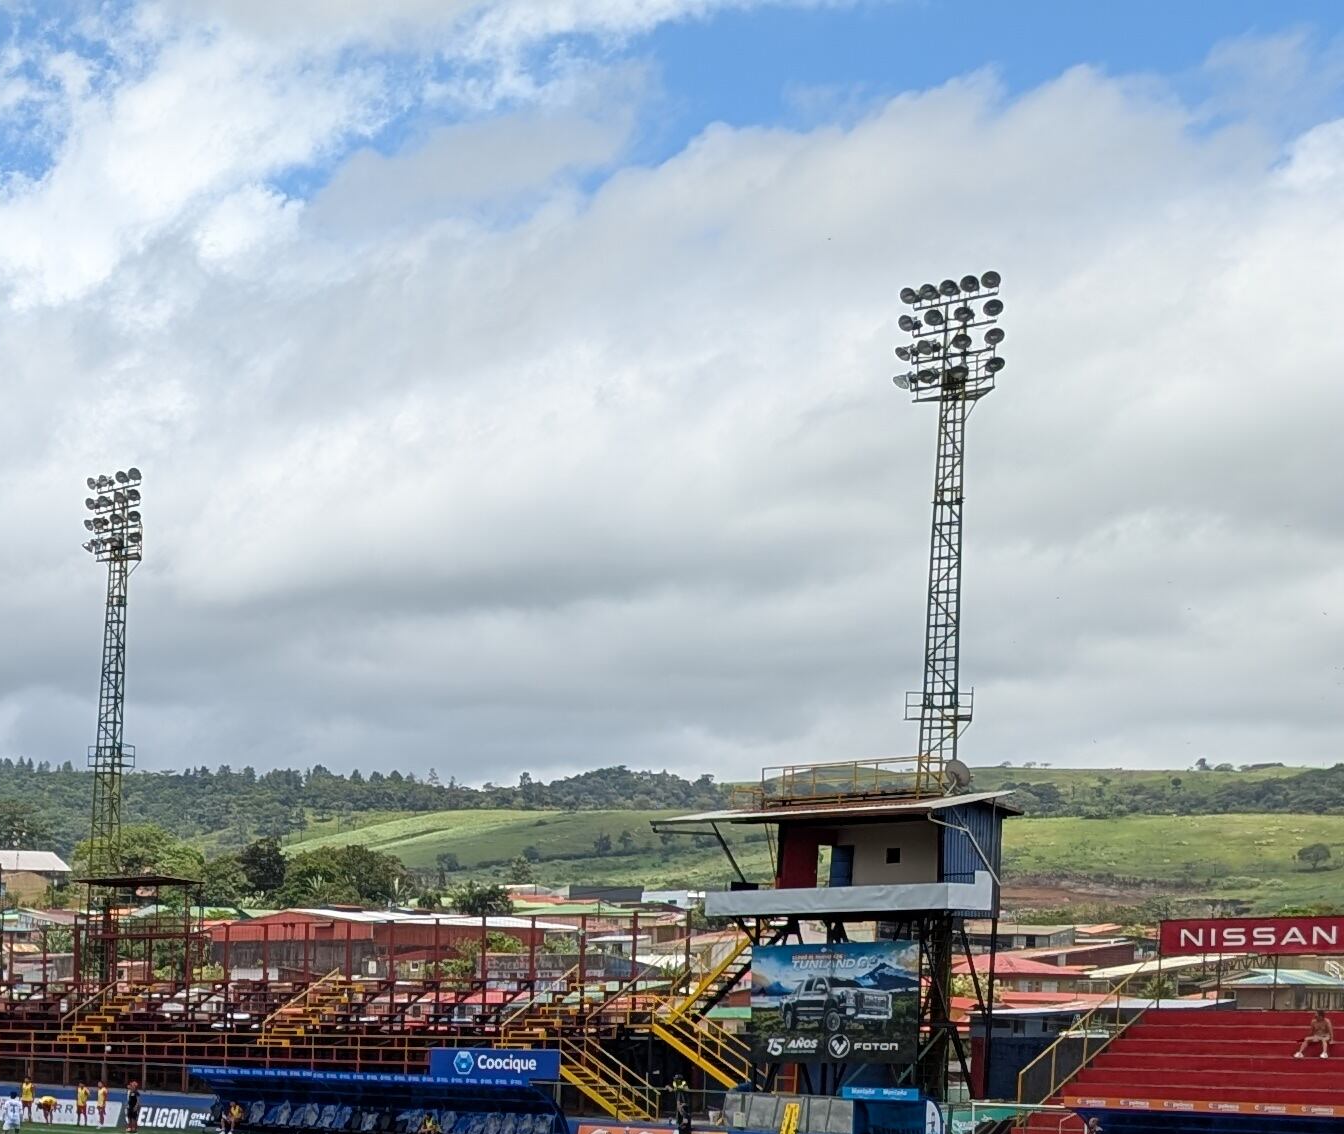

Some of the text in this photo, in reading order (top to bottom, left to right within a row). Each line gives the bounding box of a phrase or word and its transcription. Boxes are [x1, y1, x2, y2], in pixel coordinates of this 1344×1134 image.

[1179, 926, 1338, 947] NISSAN
[791, 959, 856, 970] TUNLAND
[766, 1036, 819, 1057] 15 AÑOS
[853, 1042, 900, 1052] FOTON
[477, 1054, 538, 1074] Coocique
